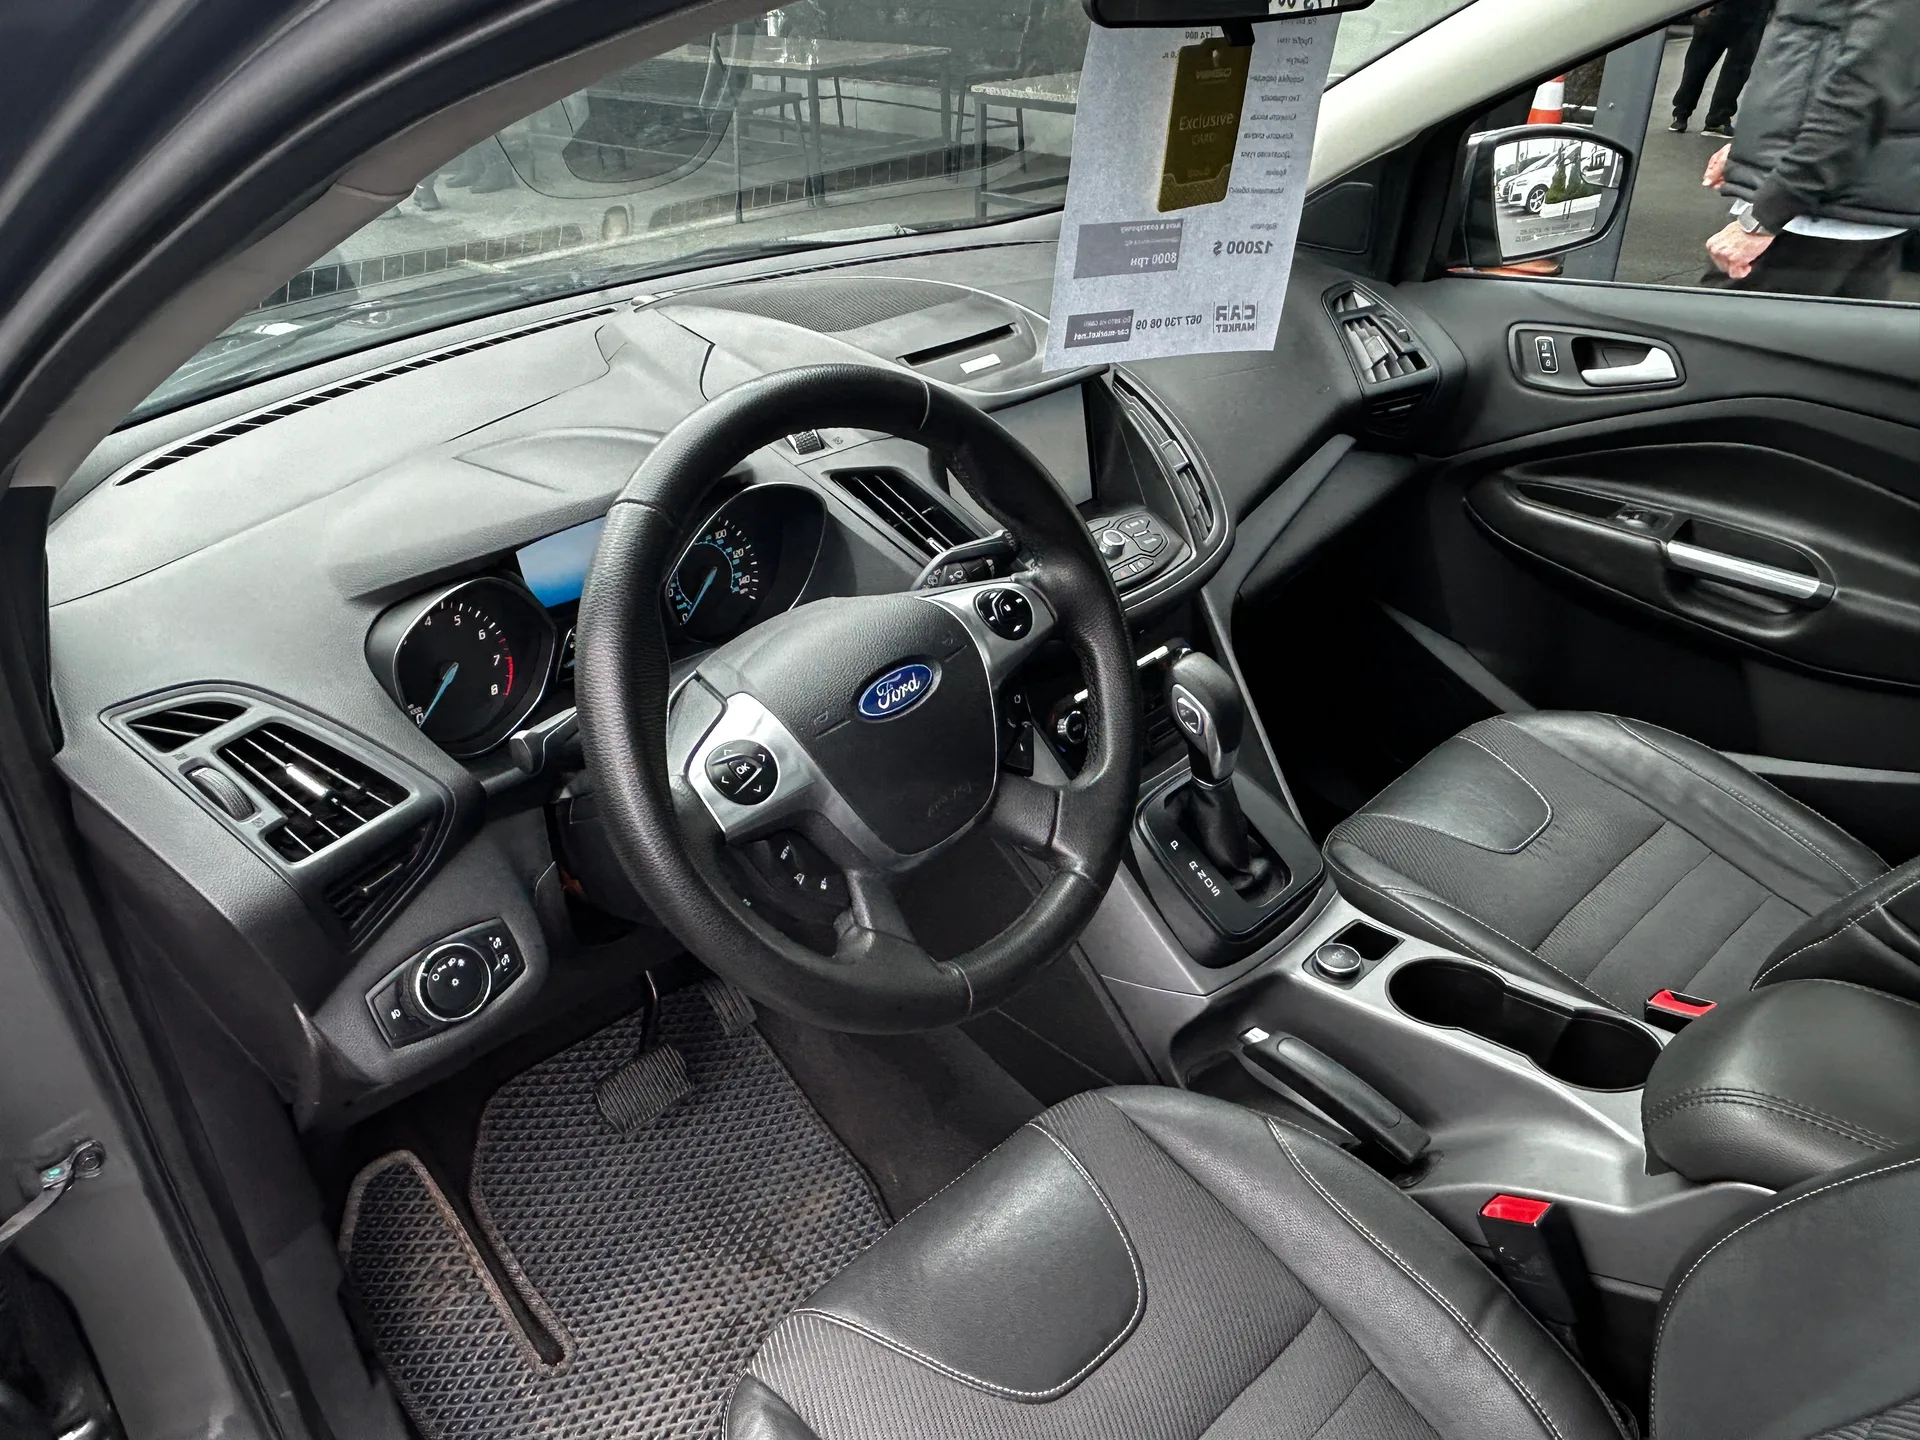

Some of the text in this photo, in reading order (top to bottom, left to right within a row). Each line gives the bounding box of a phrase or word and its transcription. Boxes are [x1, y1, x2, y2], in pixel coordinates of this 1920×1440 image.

[1179, 113, 1235, 131] Exclusive
[715, 529, 727, 540] 100
[424, 615, 432, 626] 4
[454, 615, 461, 626] 5
[478, 629, 486, 640] 6
[493, 654, 500, 666] 7
[490, 684, 498, 696] 8
[876, 672, 921, 710] Ford
[736, 763, 750, 775] OK
[1170, 840, 1179, 850] P
[1188, 861, 1198, 871] R
[1197, 869, 1207, 880] N
[1211, 885, 1220, 897] S
